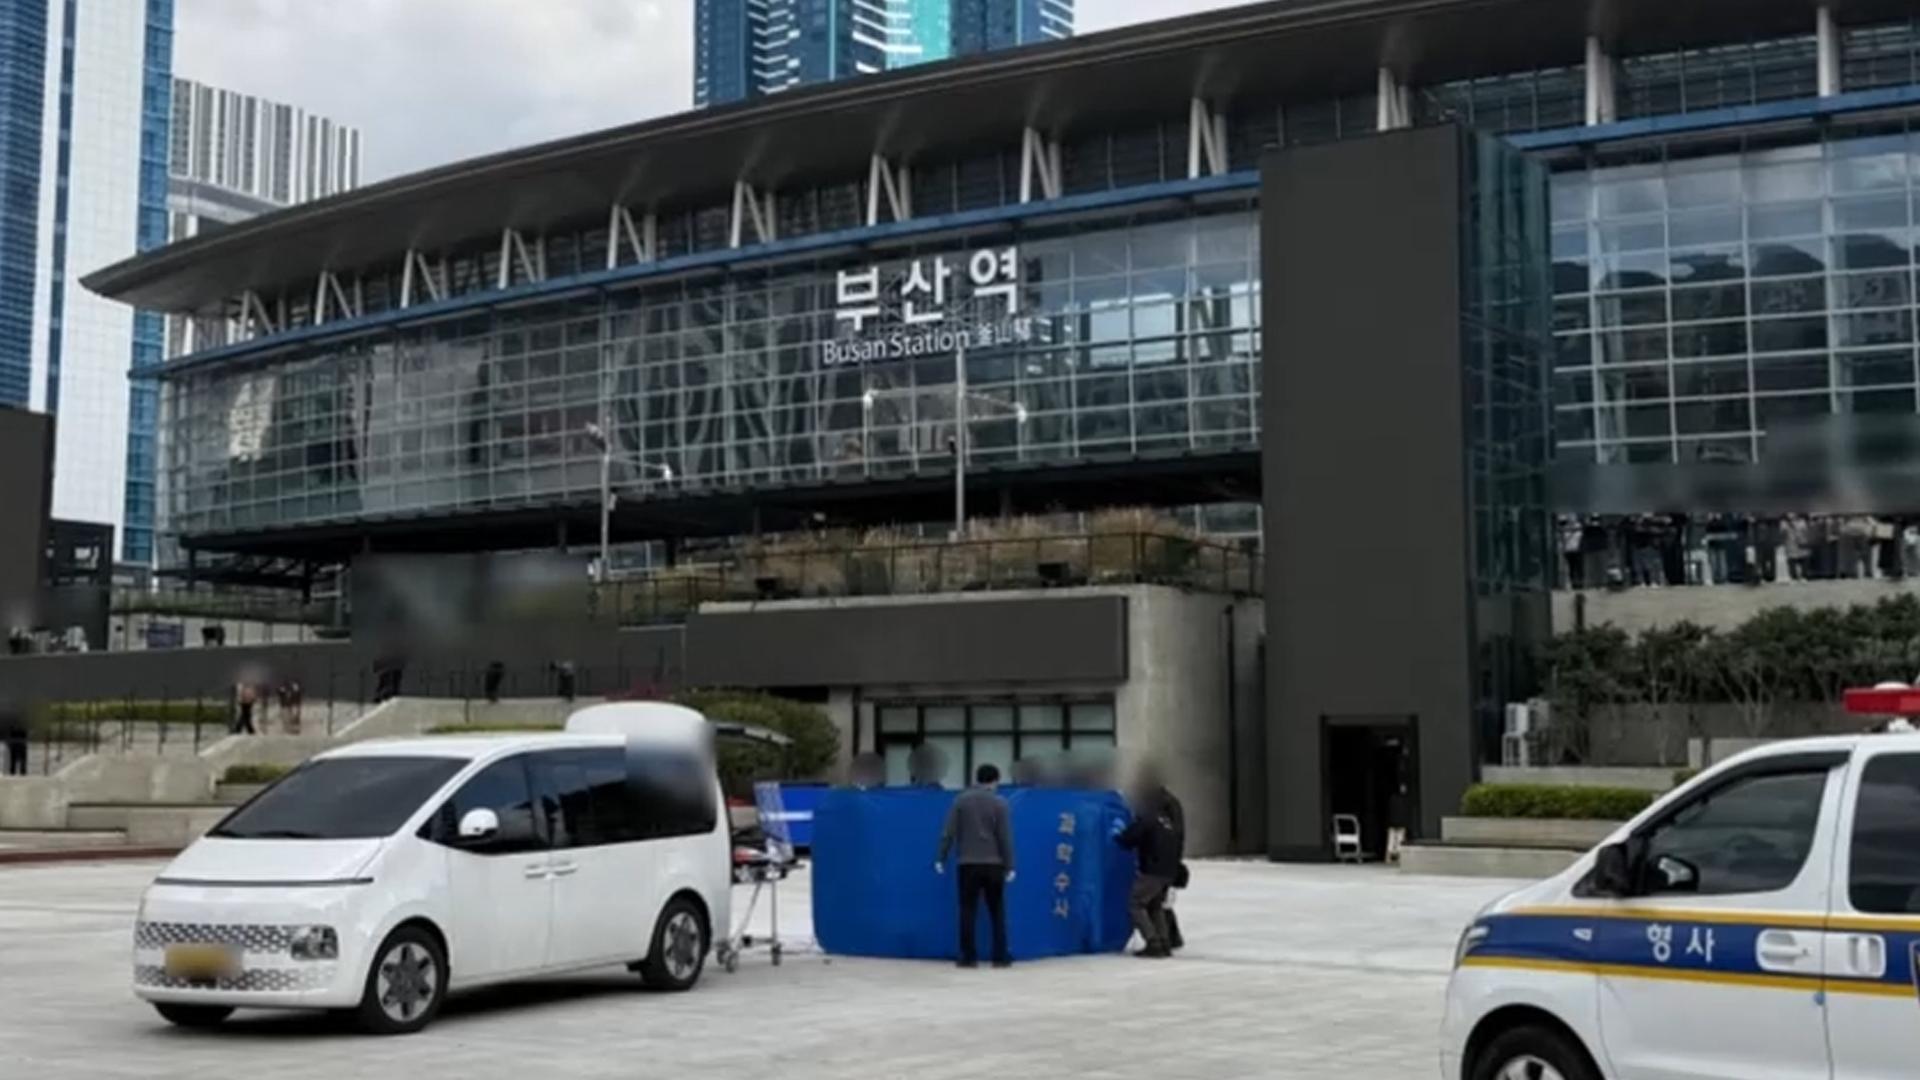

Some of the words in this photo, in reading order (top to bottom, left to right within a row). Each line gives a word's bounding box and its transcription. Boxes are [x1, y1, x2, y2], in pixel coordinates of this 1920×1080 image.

[835, 246, 1017, 331] 부산역
[822, 339, 887, 364] Busan
[889, 330, 970, 358] Station
[1647, 923, 1715, 963] 형사
